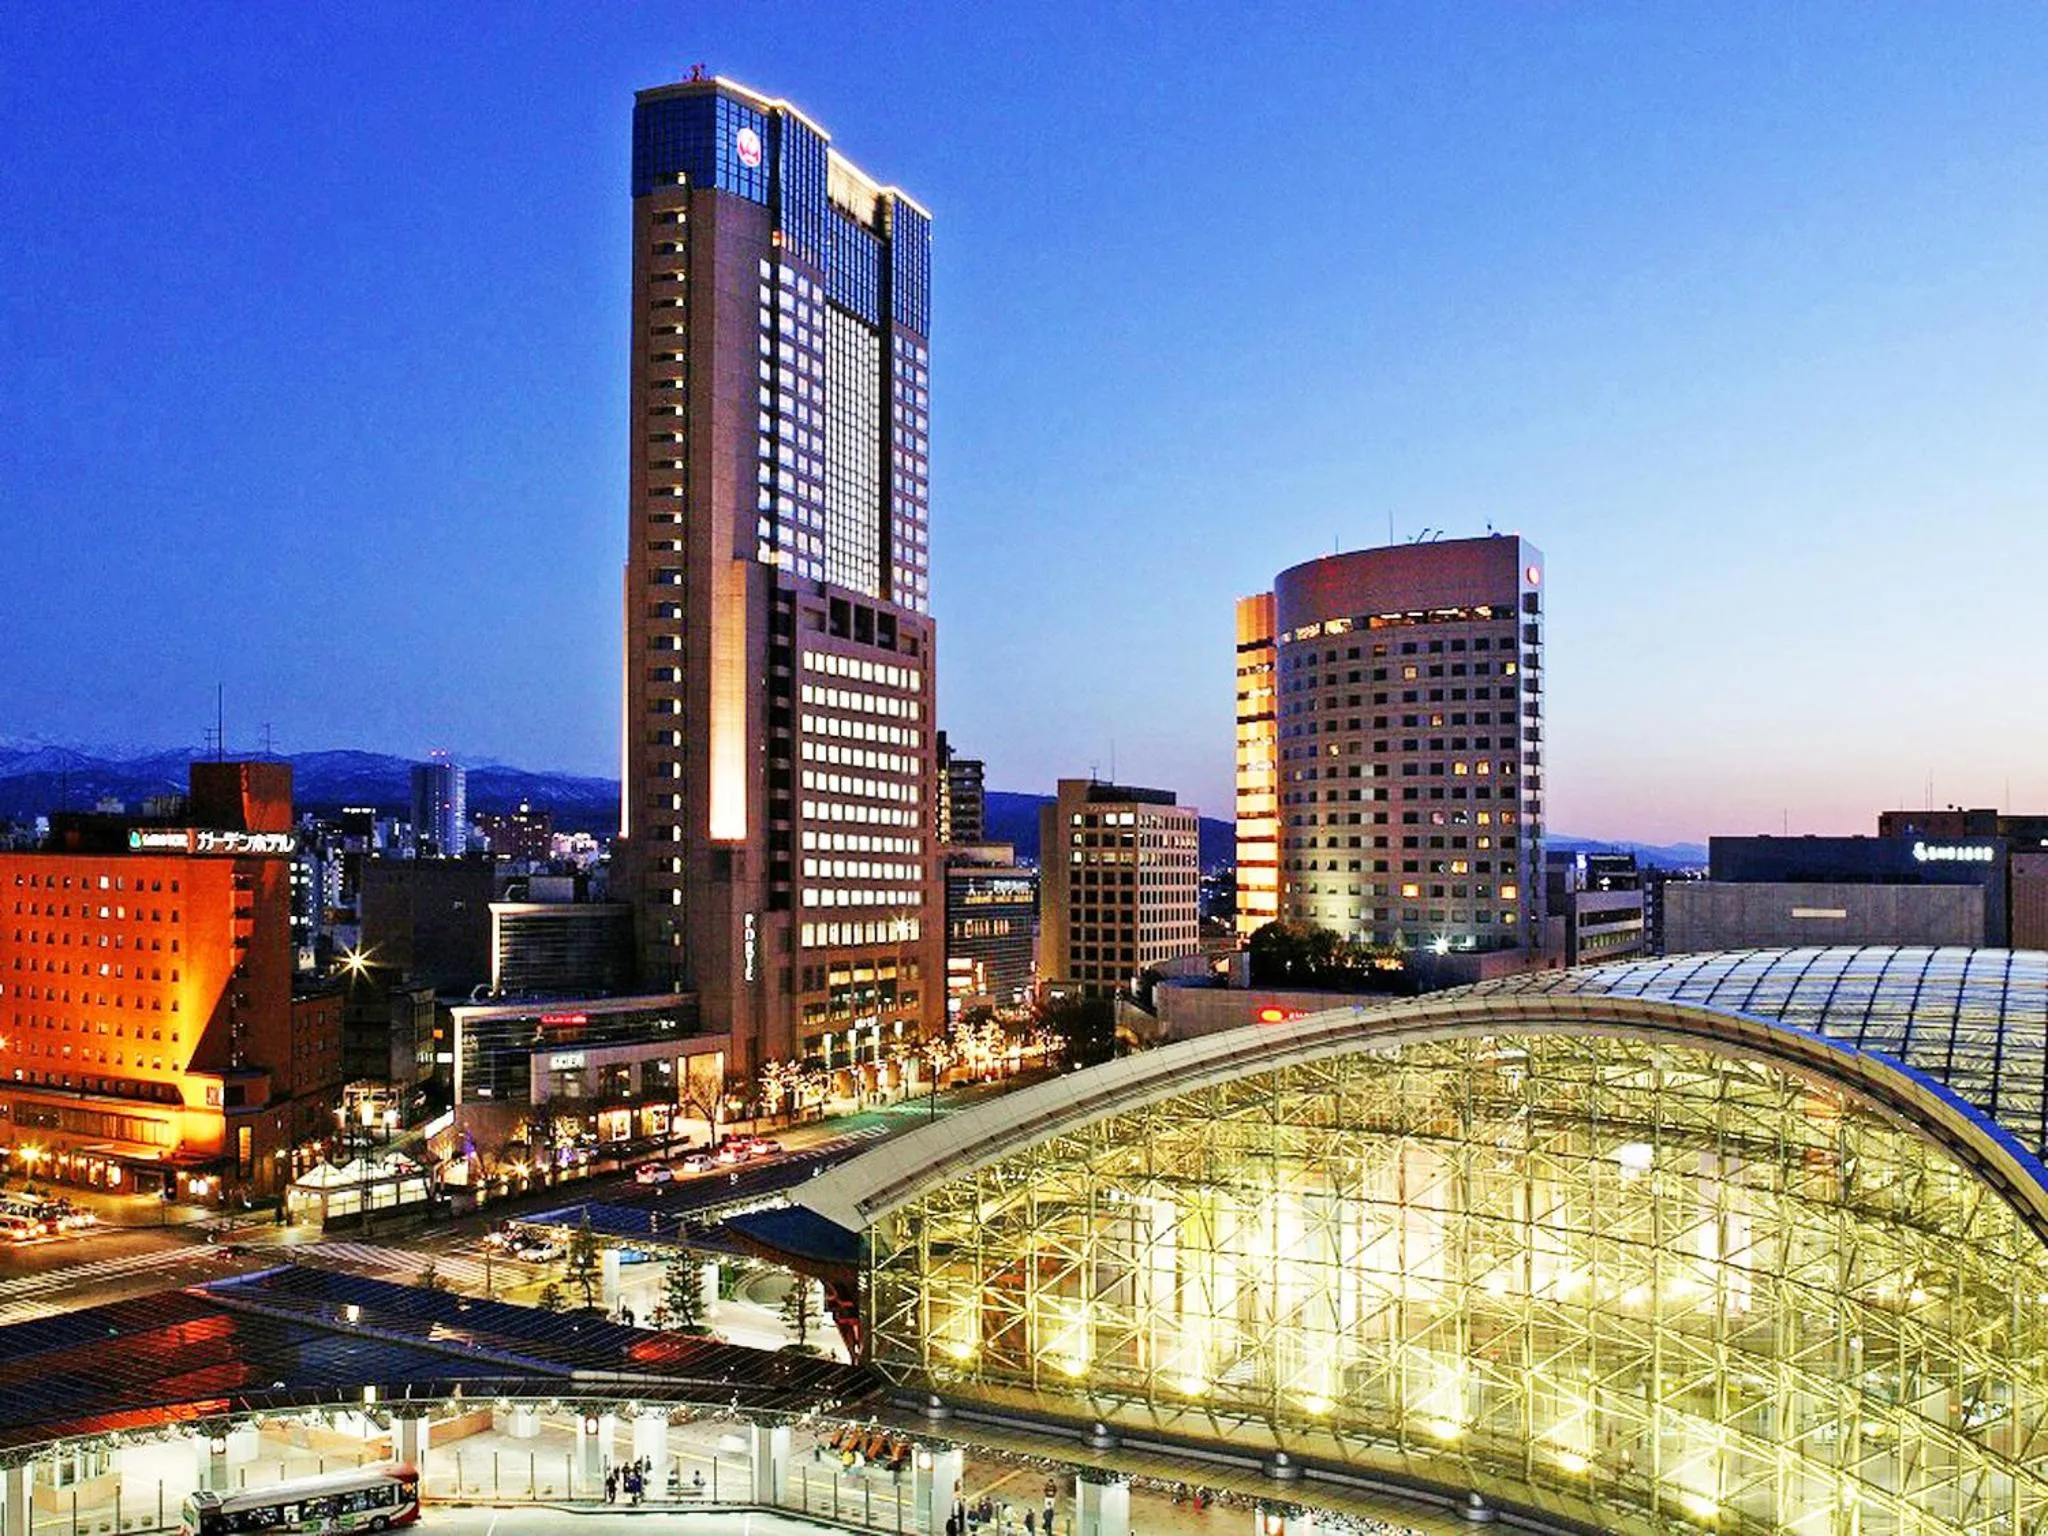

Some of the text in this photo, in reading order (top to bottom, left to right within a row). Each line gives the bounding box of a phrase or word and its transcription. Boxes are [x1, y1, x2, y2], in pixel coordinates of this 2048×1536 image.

[197, 831, 296, 852] ガーデンホテル
